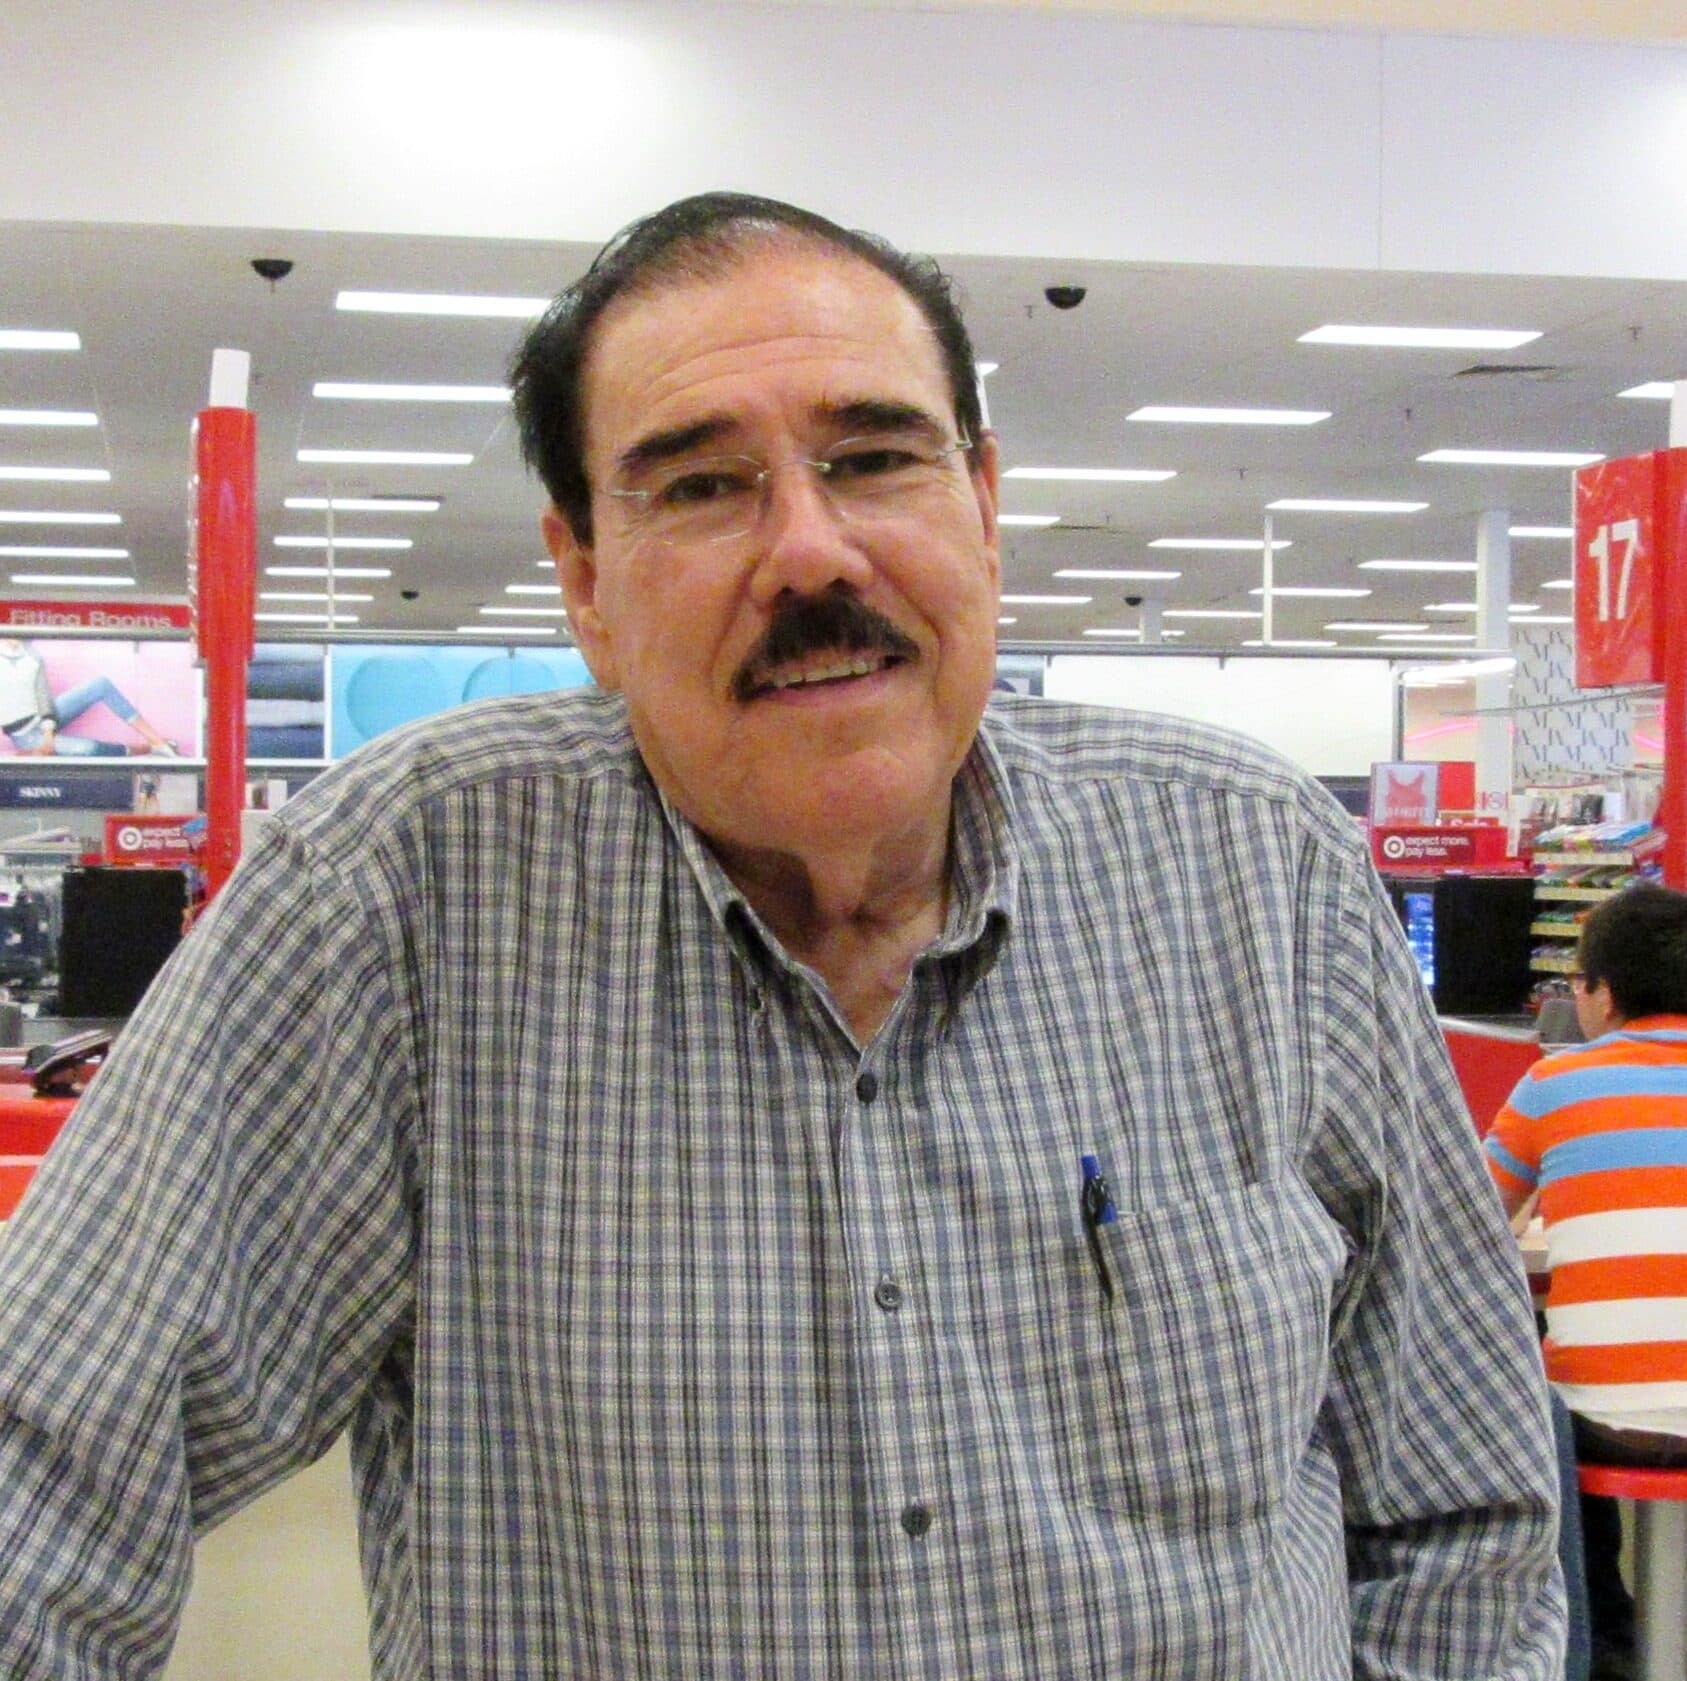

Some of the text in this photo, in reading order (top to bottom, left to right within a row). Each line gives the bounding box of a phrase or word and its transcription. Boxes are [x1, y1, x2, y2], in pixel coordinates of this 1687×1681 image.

[1588, 519, 1639, 622] 17
[11, 609, 172, 629] Fitting Rooms
